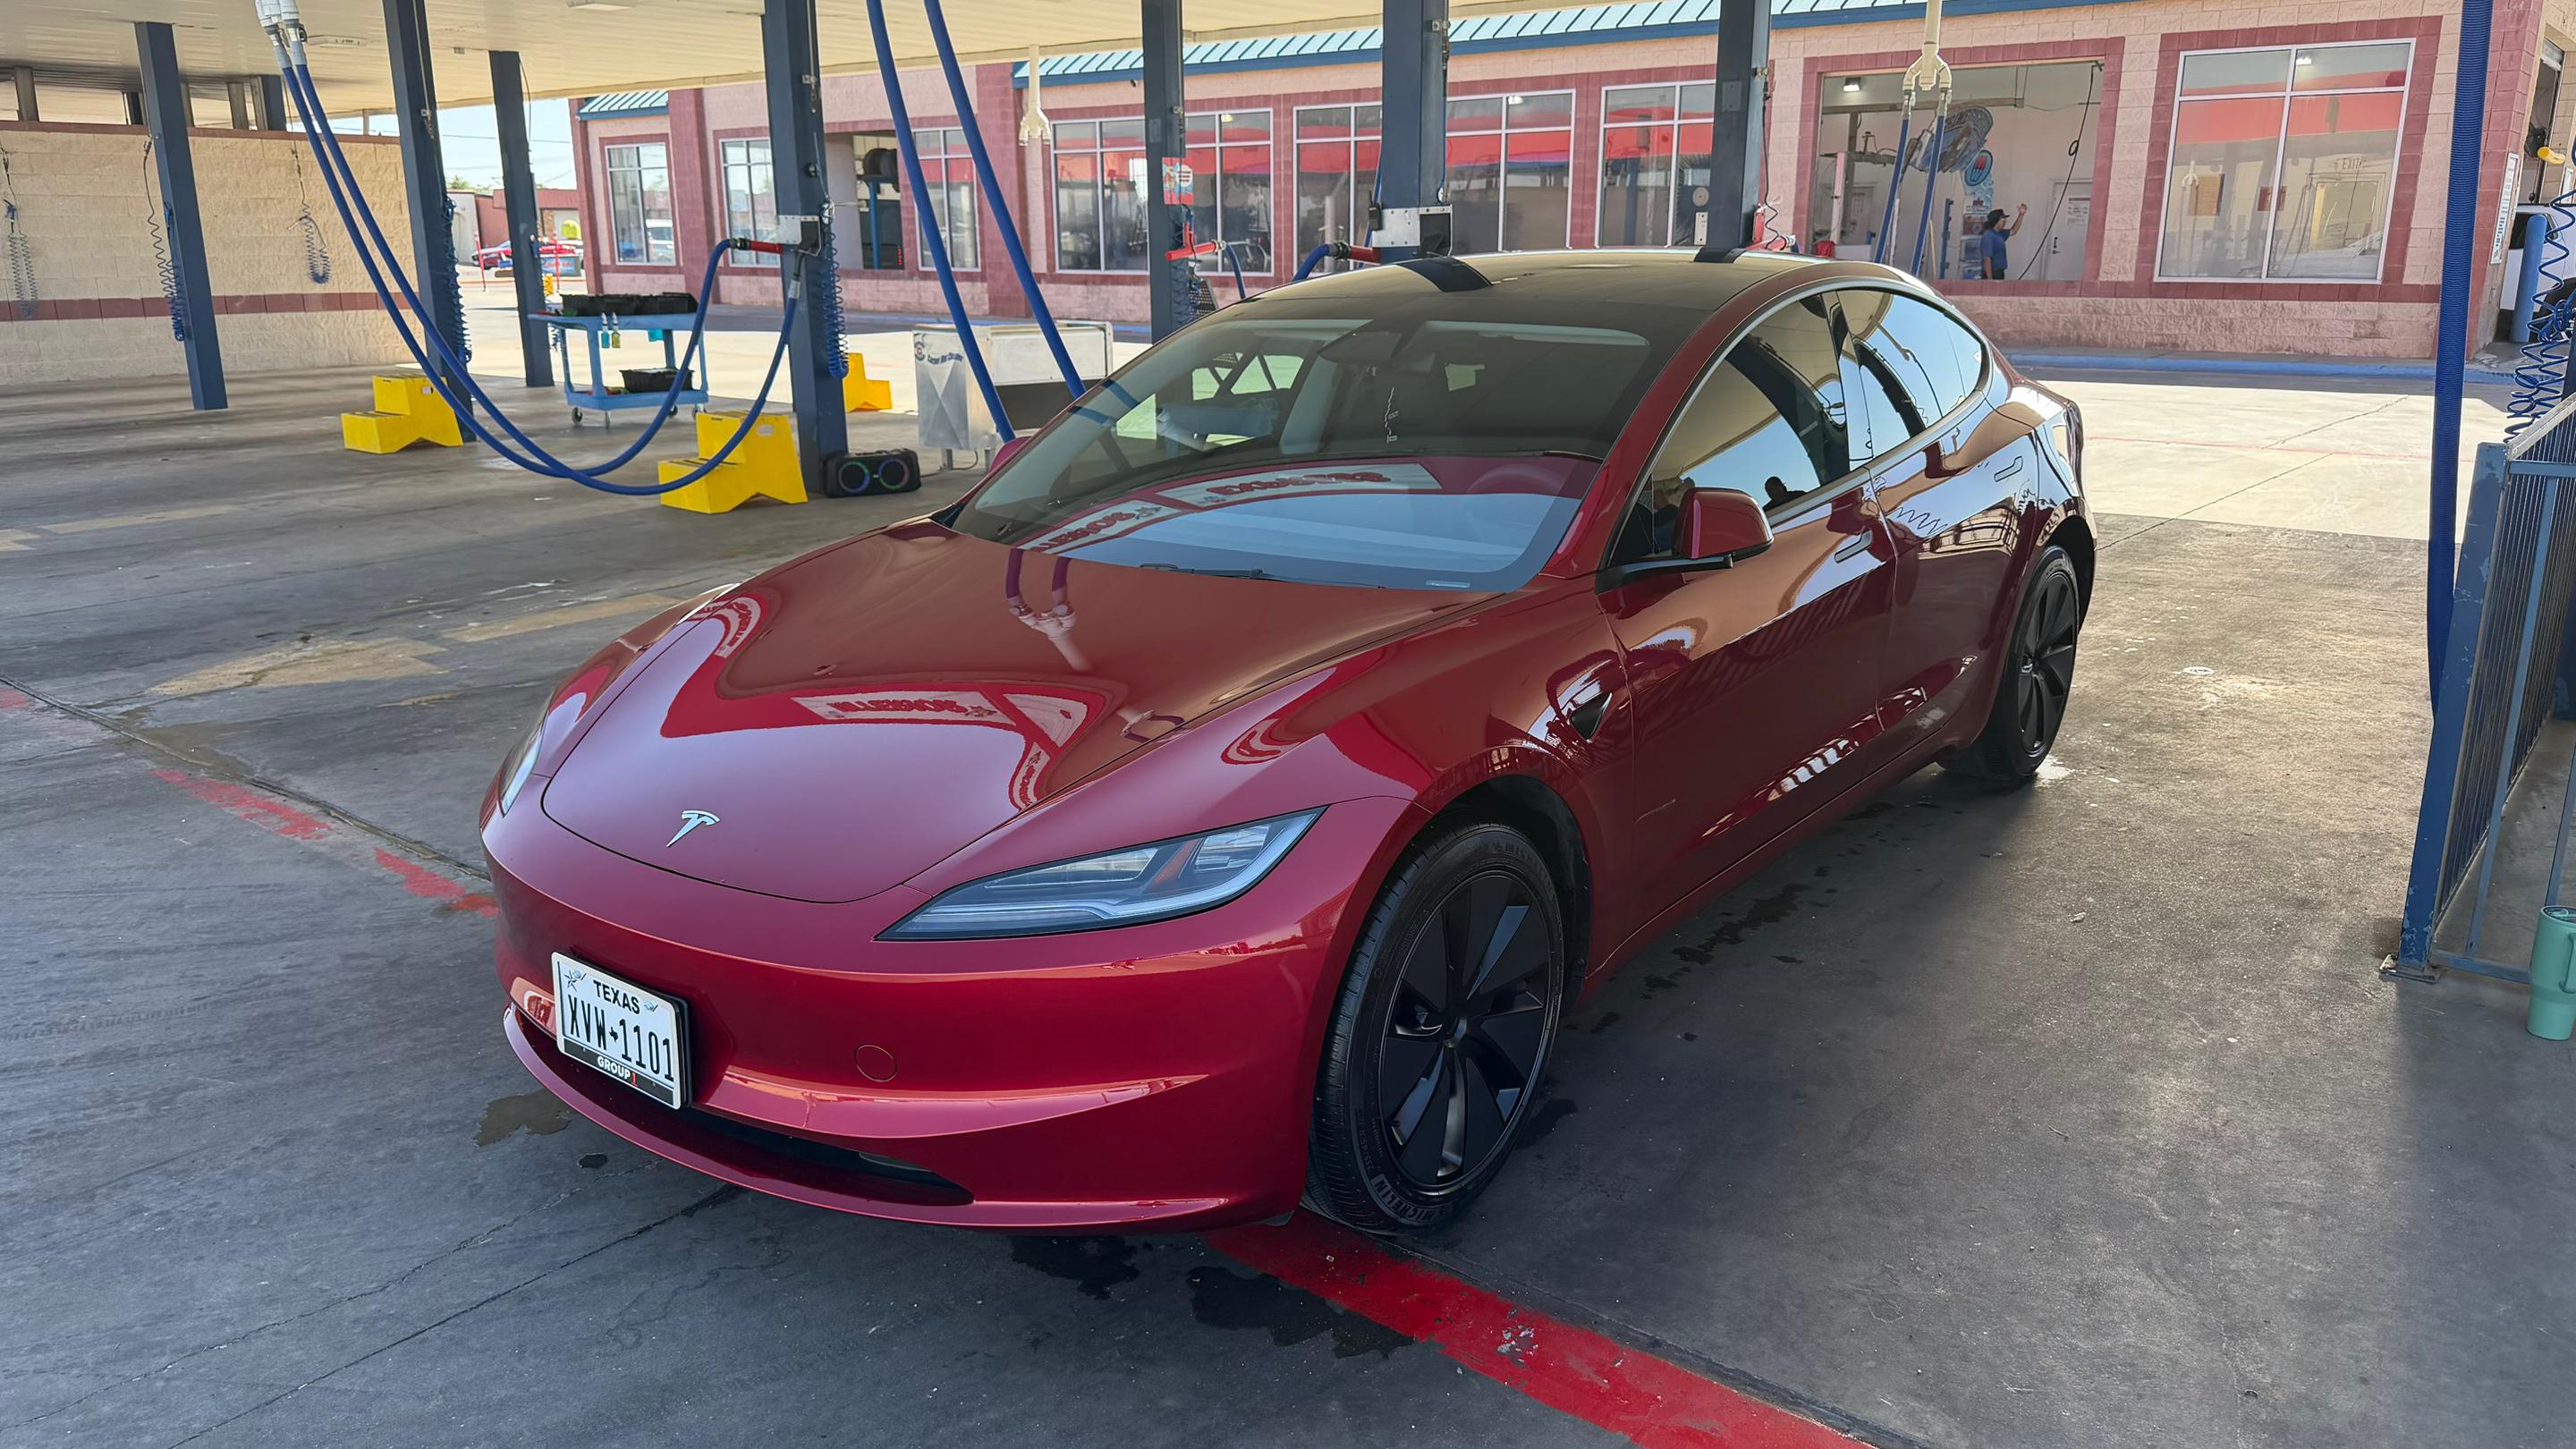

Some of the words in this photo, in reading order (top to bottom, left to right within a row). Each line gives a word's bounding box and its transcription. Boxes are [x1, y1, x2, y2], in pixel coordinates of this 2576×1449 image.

[2343, 157, 2360, 170] EXIT
[593, 979, 640, 1014] TEXAS
[597, 1055, 631, 1080] GROUP
[1374, 1179, 1436, 1222] MICHELIN
